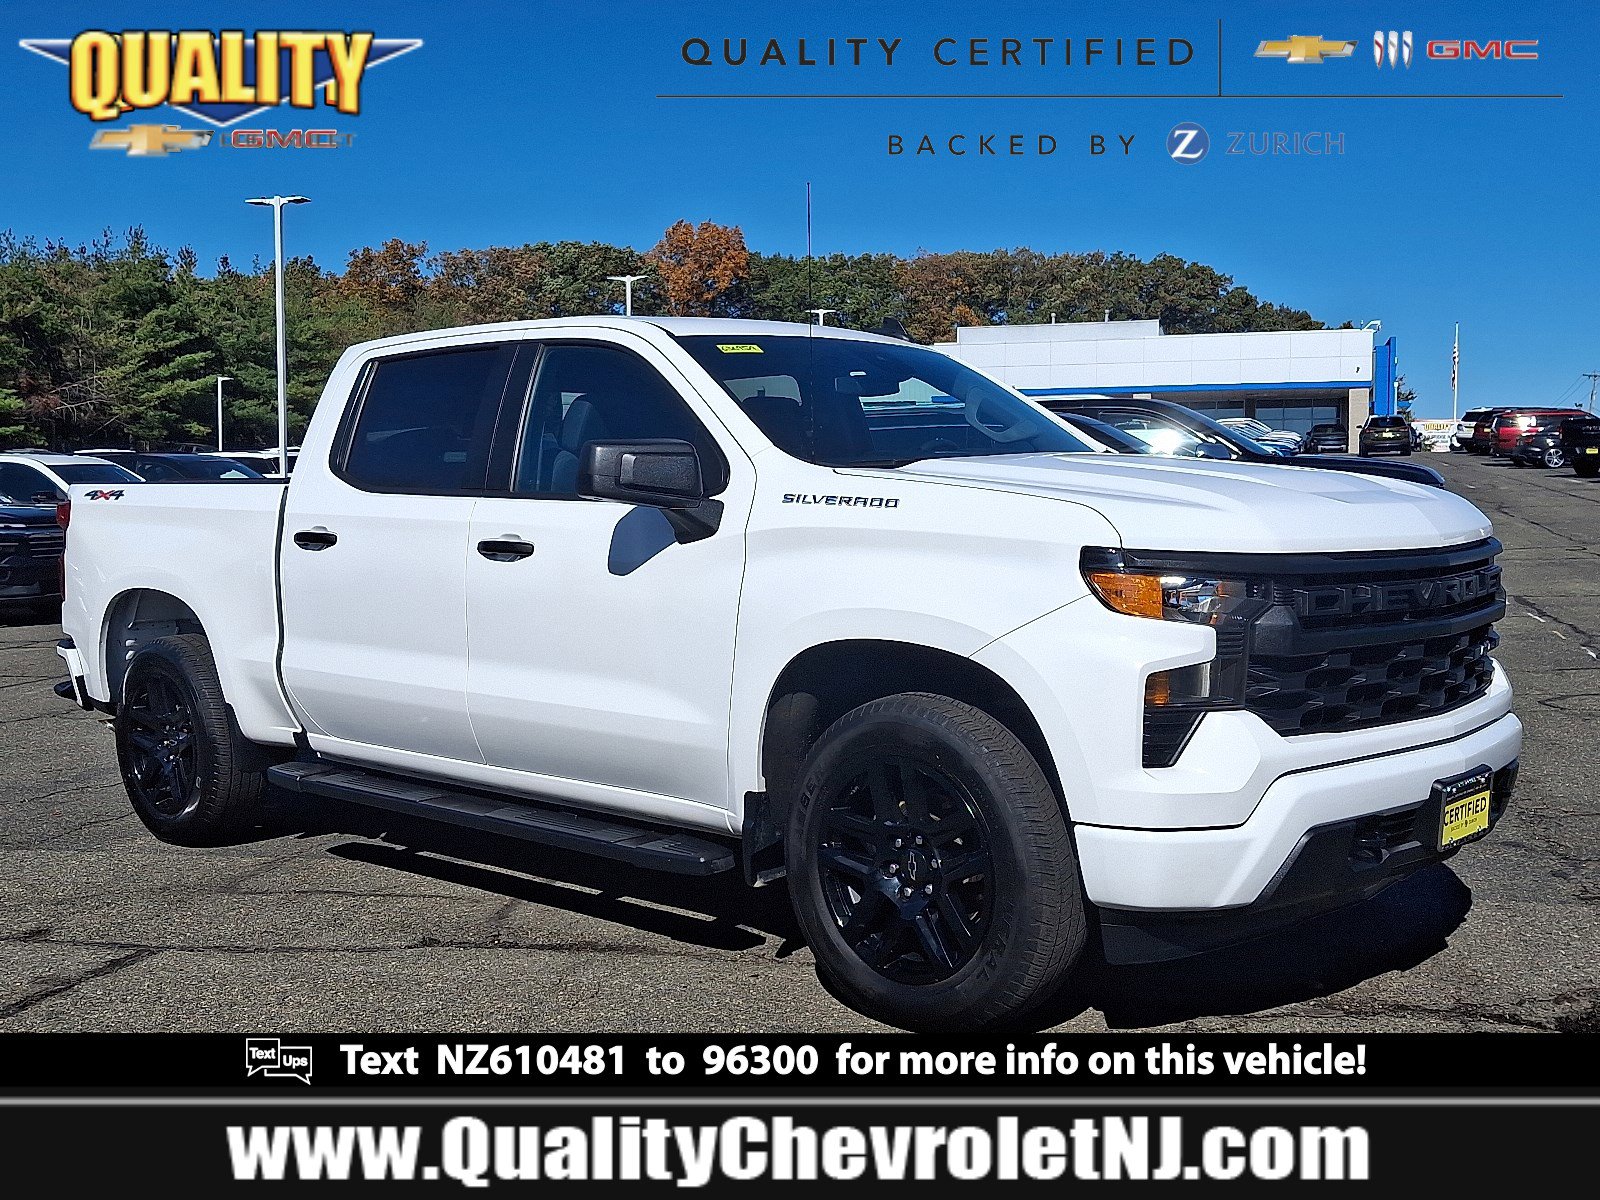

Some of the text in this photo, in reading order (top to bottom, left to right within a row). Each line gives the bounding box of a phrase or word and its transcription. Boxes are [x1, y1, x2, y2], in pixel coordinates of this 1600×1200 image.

[782, 493, 900, 508] SILVERADO
[1306, 565, 1502, 617] CHEVROLE
[1443, 796, 1487, 827] CERTIFIED
